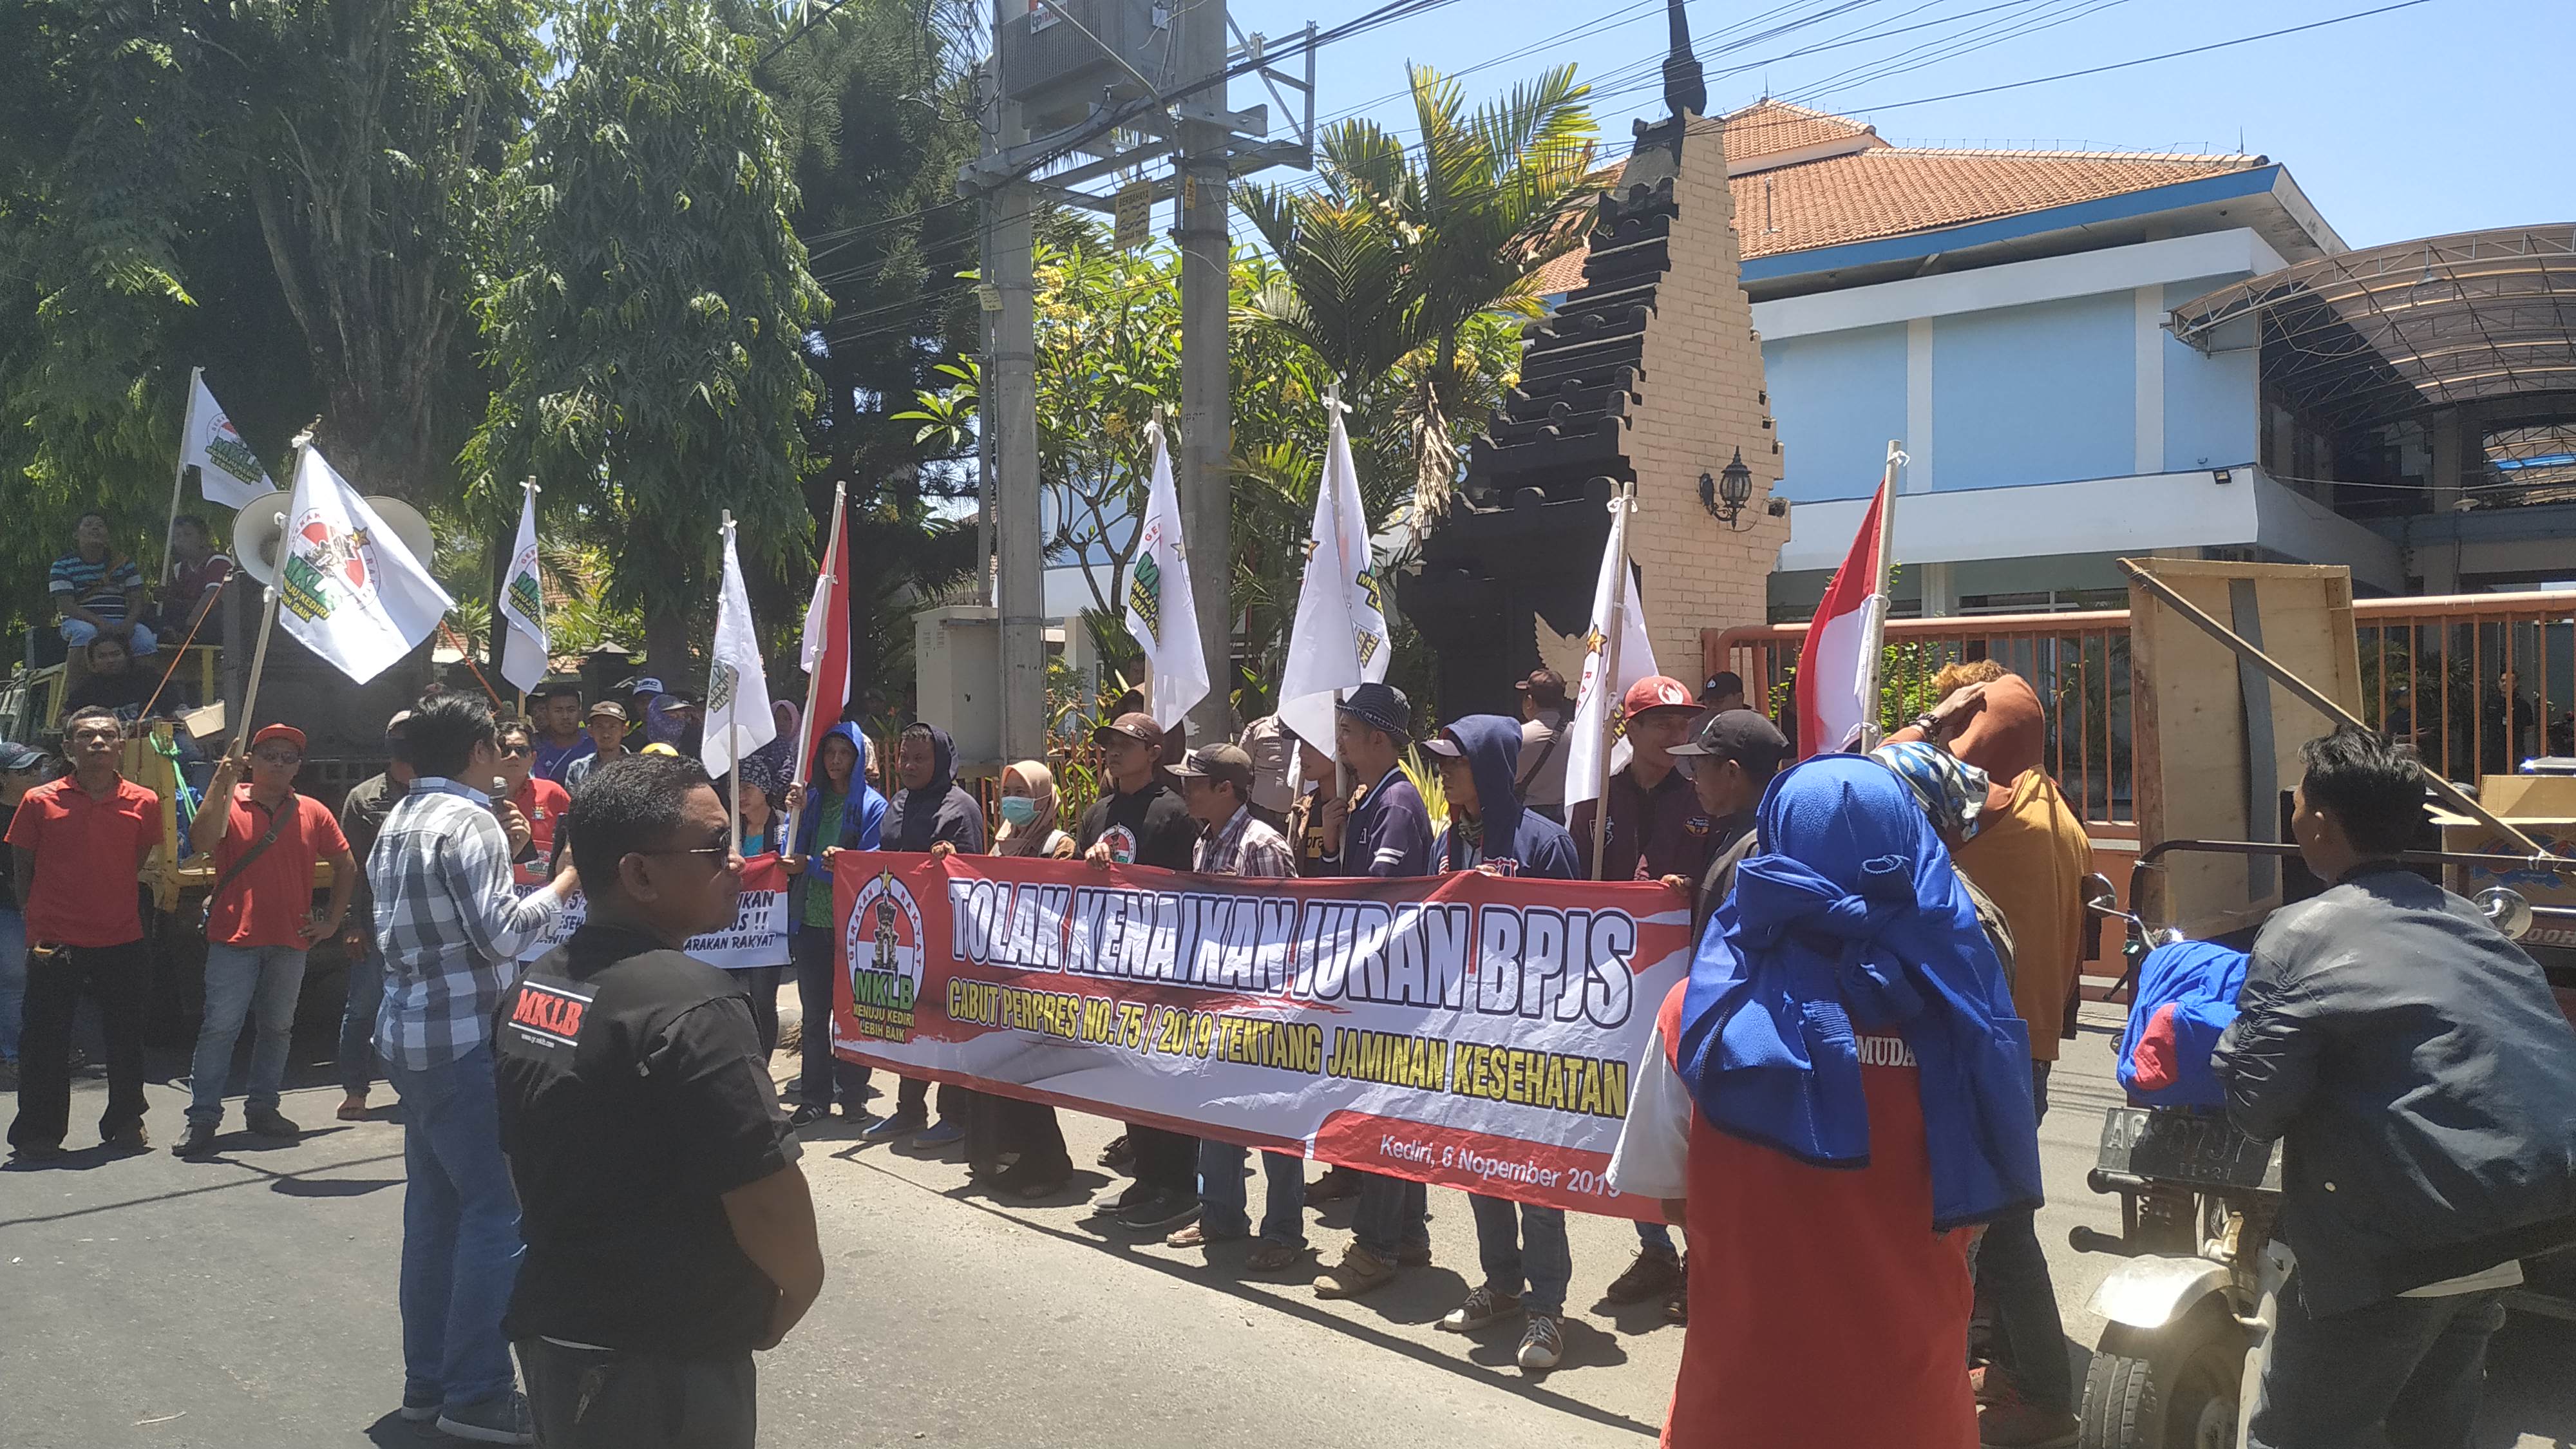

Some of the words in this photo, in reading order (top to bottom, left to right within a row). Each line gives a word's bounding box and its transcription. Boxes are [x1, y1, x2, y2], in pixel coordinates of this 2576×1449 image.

[291, 601, 312, 621] BAIK
[509, 596, 532, 618] LEBIH
[732, 934, 775, 949] RAKYAT
[848, 887, 874, 962] GERAKAN
[900, 890, 922, 968] RAKYAT
[949, 879, 1070, 970] TOLAK
[1066, 887, 1298, 993] KENAIKAN
[1293, 901, 1470, 1010] IURAN
[1476, 906, 1634, 1029] BPJS
[513, 989, 583, 1036] MKLB
[854, 968, 915, 1012] MKLB
[852, 1003, 887, 1023] MENUJU
[886, 1009, 915, 1028] KEDIRI
[859, 1019, 884, 1039] LEBIH
[886, 1024, 906, 1045] BAIK
[948, 979, 1000, 1027] CABUT
[1001, 987, 1080, 1039] PERPRES
[1216, 1014, 1325, 1075] TENTANG
[1327, 1026, 1448, 1094] JAMINAN
[1451, 1041, 1629, 1121] KESEHATAN
[1379, 1133, 1435, 1169] Kediri,
[1441, 1145, 1455, 1168] 6
[1457, 1148, 1562, 1189] Nopember
